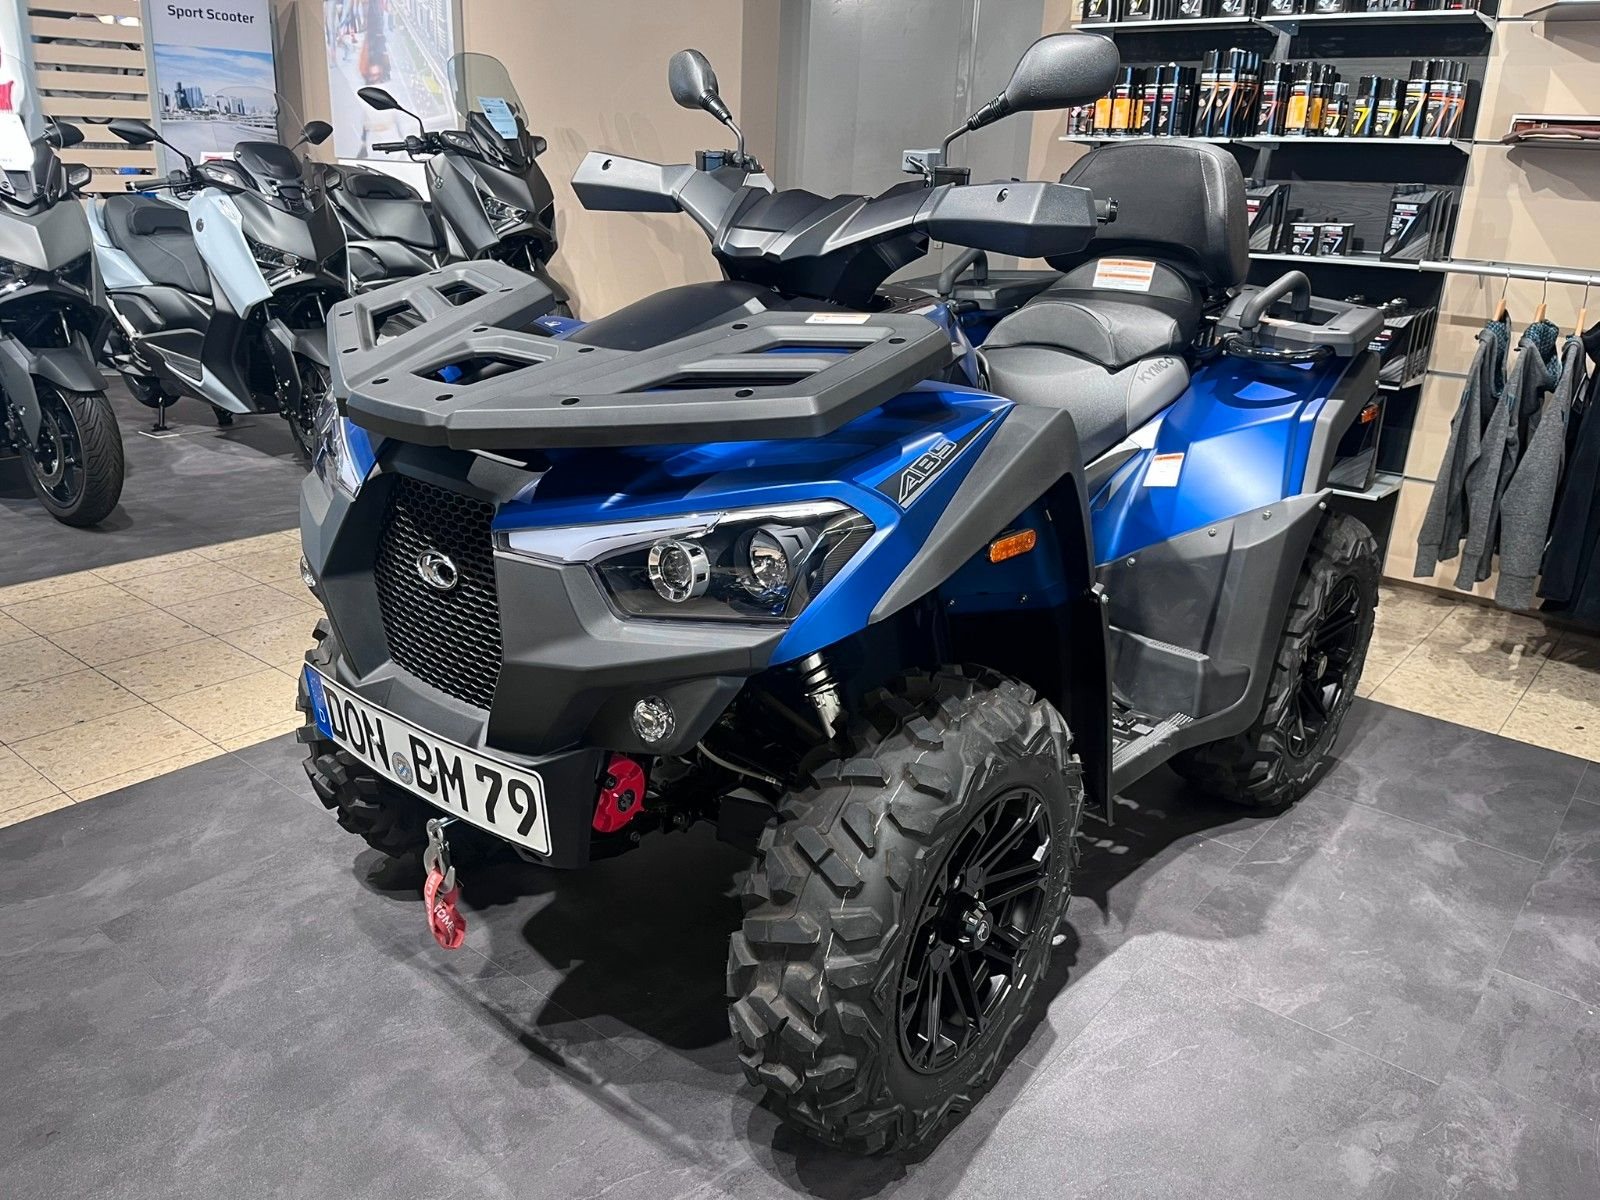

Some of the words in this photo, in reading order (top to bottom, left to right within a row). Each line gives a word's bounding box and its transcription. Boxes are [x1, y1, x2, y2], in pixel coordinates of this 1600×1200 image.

[167, 4, 204, 19] Sport
[206, 8, 255, 24] Scooter
[1138, 356, 1175, 383] KYMCO
[898, 436, 958, 505] ABS
[321, 683, 391, 772] DON
[408, 733, 469, 813] BM
[474, 763, 538, 837] 79
